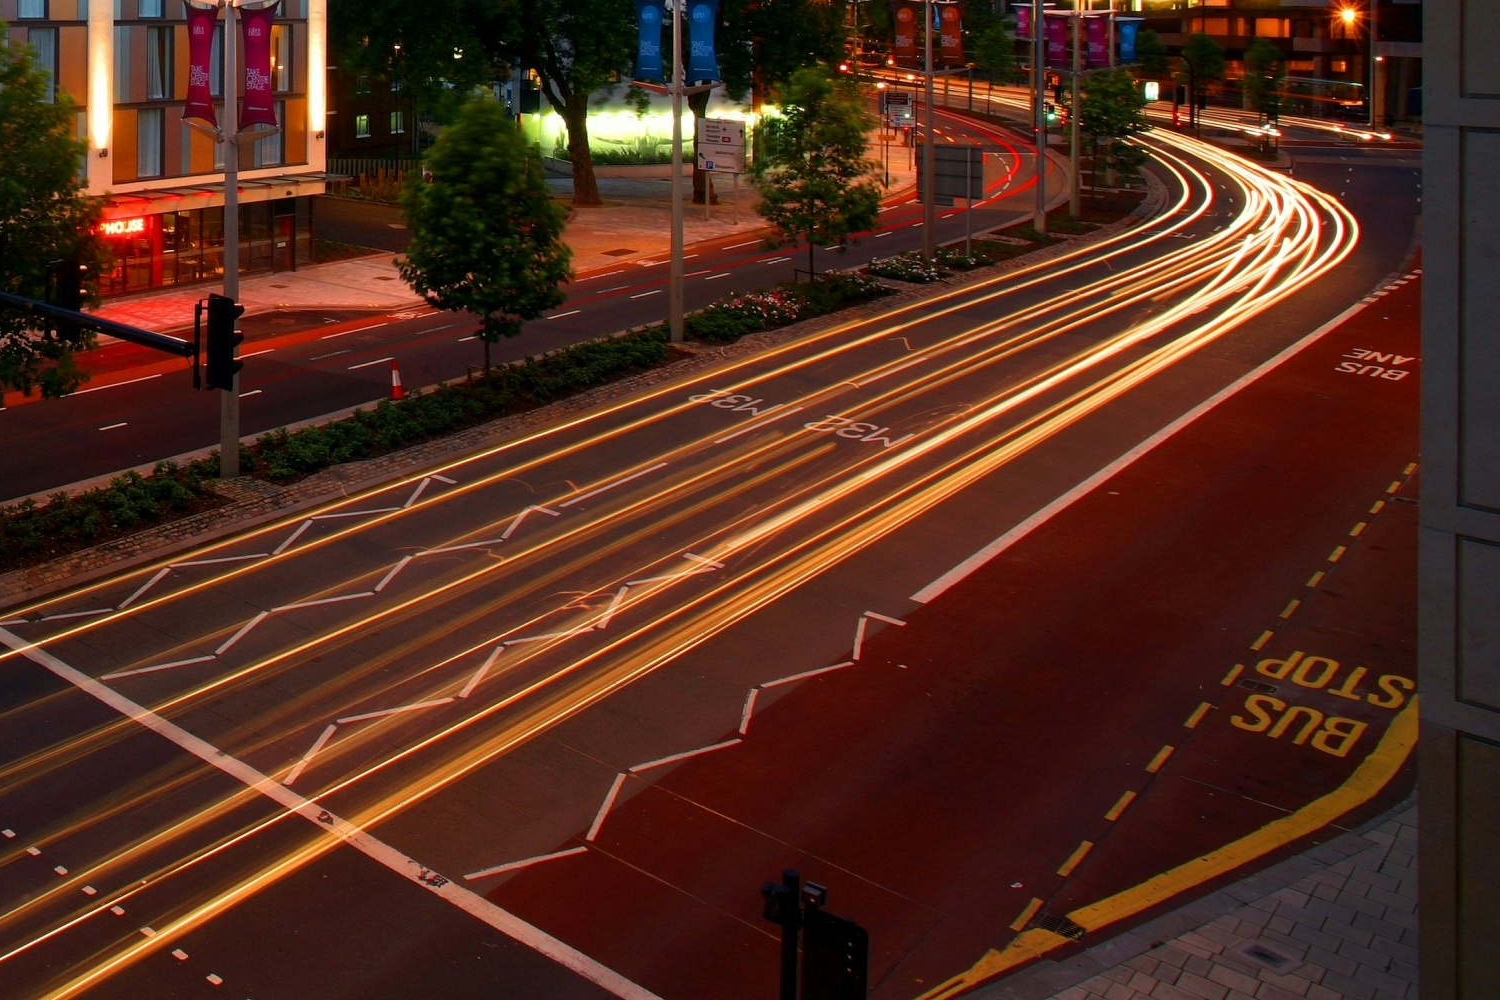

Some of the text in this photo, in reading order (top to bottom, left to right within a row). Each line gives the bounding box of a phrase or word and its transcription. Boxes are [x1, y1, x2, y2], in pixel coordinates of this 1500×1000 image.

[1335, 361, 1410, 381] BUS
[688, 388, 784, 418] M32
[803, 414, 915, 448] M32
[1255, 650, 1415, 709] STOP
[1230, 694, 1370, 757] BUS
